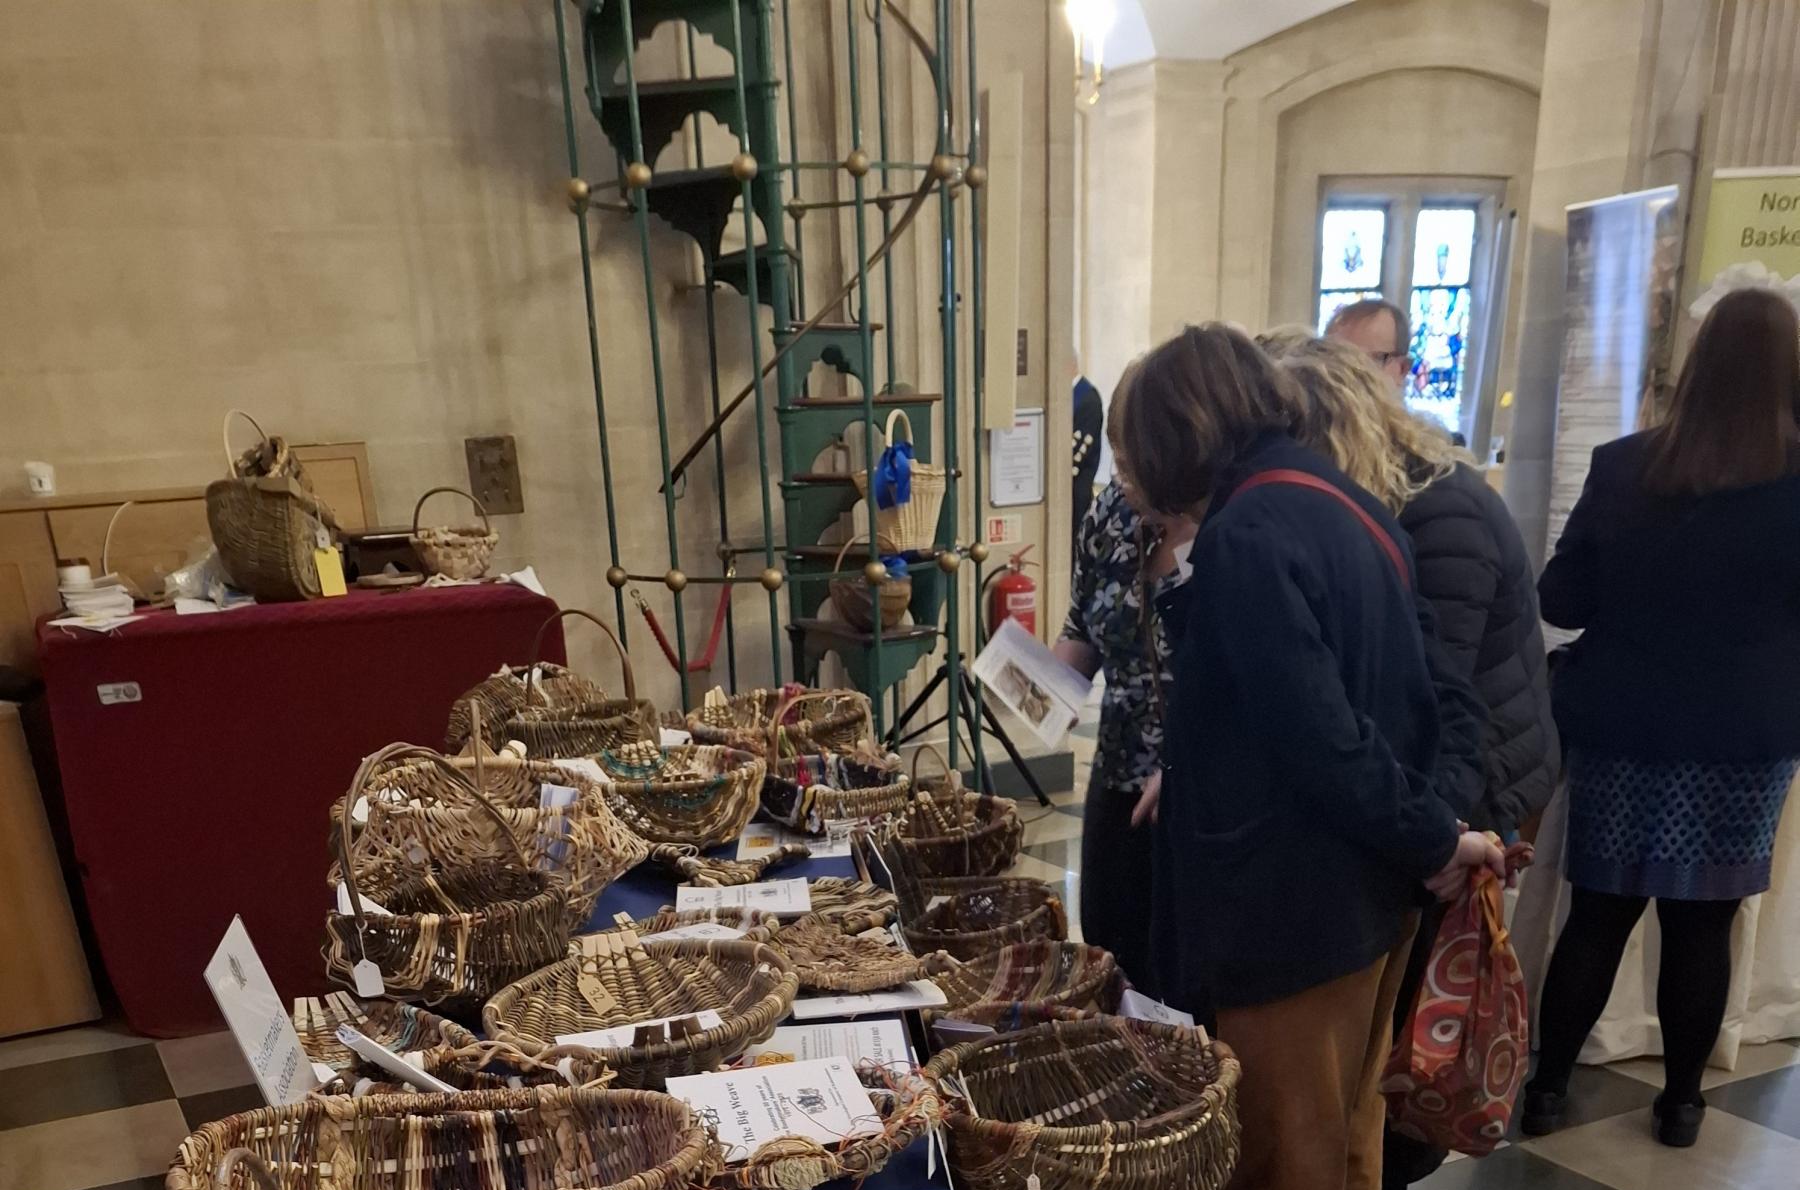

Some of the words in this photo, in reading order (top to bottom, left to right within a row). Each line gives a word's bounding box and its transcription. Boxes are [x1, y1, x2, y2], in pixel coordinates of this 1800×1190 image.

[588, 987, 605, 1002] 32
[726, 1083, 742, 1109] Weave
[736, 1110, 749, 1125] Big
[743, 1128, 756, 1144] The
